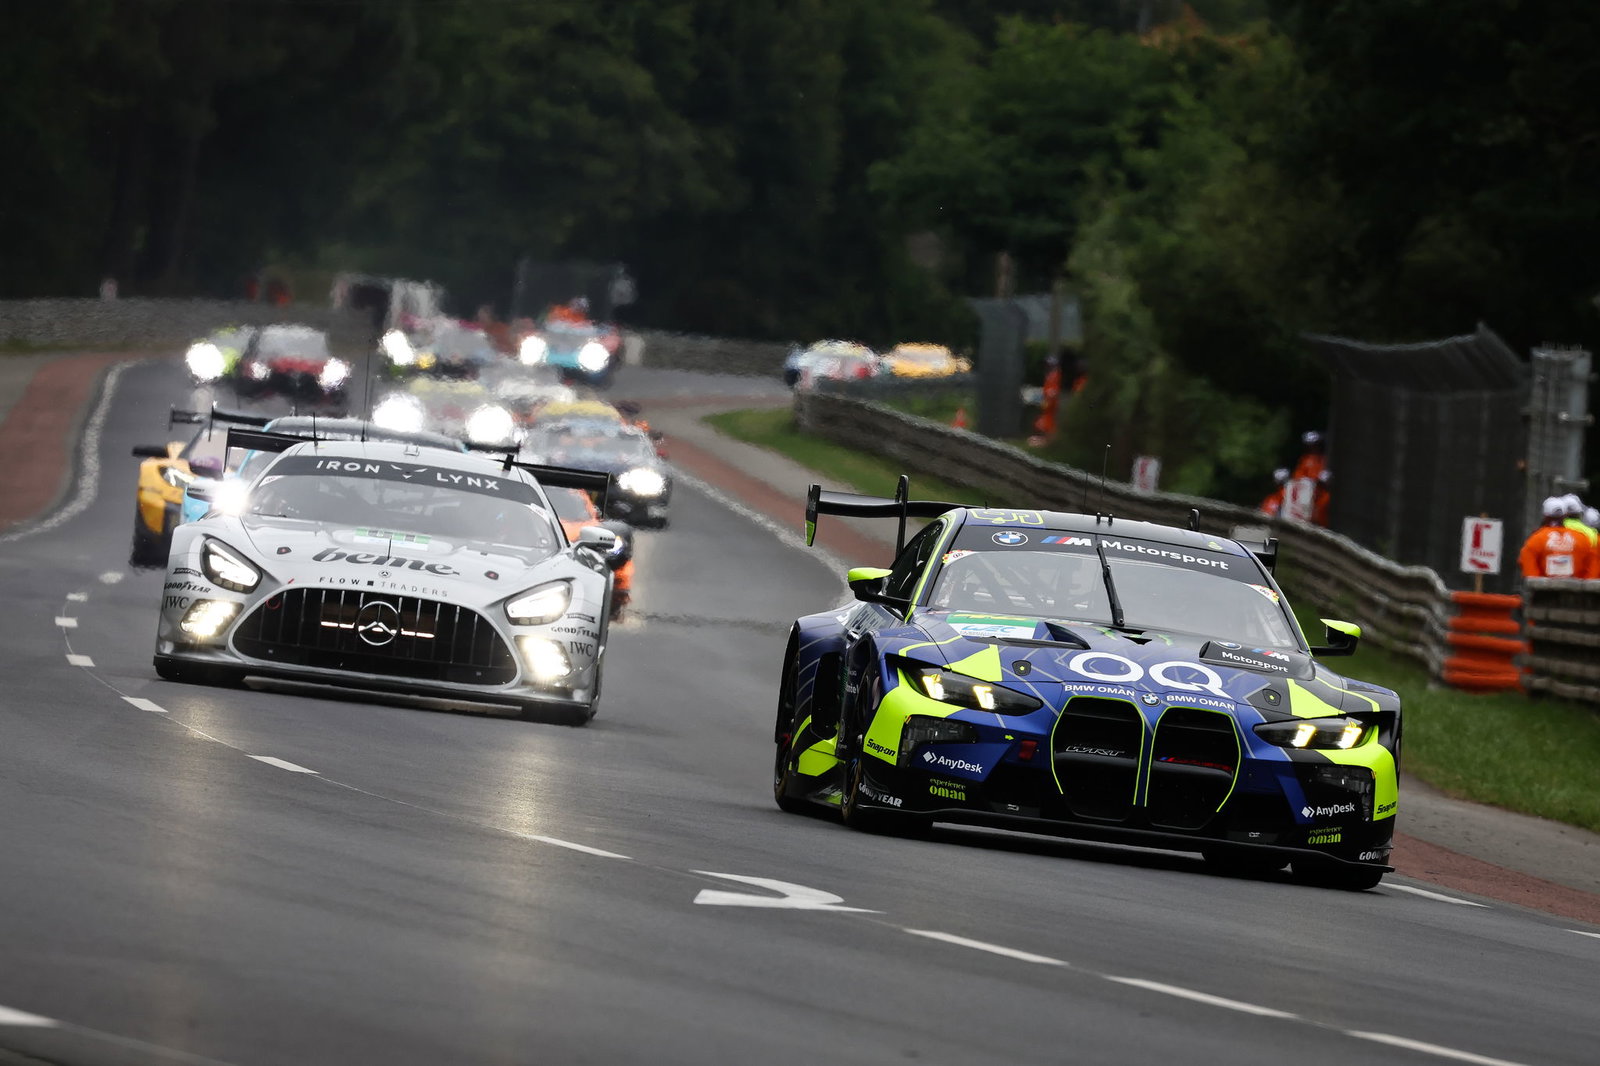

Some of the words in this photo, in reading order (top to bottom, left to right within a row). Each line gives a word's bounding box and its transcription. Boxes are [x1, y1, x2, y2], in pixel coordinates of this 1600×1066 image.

[316, 460, 381, 474] IRON
[436, 472, 500, 491] LYNX
[312, 547, 461, 576] beme
[1101, 539, 1229, 571] Motorsport
[319, 576, 360, 586] FLOW
[381, 581, 448, 597] TRADERS
[164, 596, 190, 609] IWC
[961, 625, 1017, 634] WEC
[570, 641, 594, 657] IWC
[1221, 651, 1289, 673] Motorsport
[1069, 651, 1234, 700] OQ
[1064, 684, 1095, 693] BMW
[1096, 685, 1135, 697] OMAN
[1166, 695, 1197, 705] BMW
[1198, 697, 1235, 711] OMAN
[867, 738, 896, 757] Snap-on
[937, 755, 983, 774] AnyDesk
[929, 778, 966, 790] experience
[929, 785, 966, 801] oman
[1316, 802, 1355, 817] AnyDesk
[1307, 833, 1342, 845] oman
